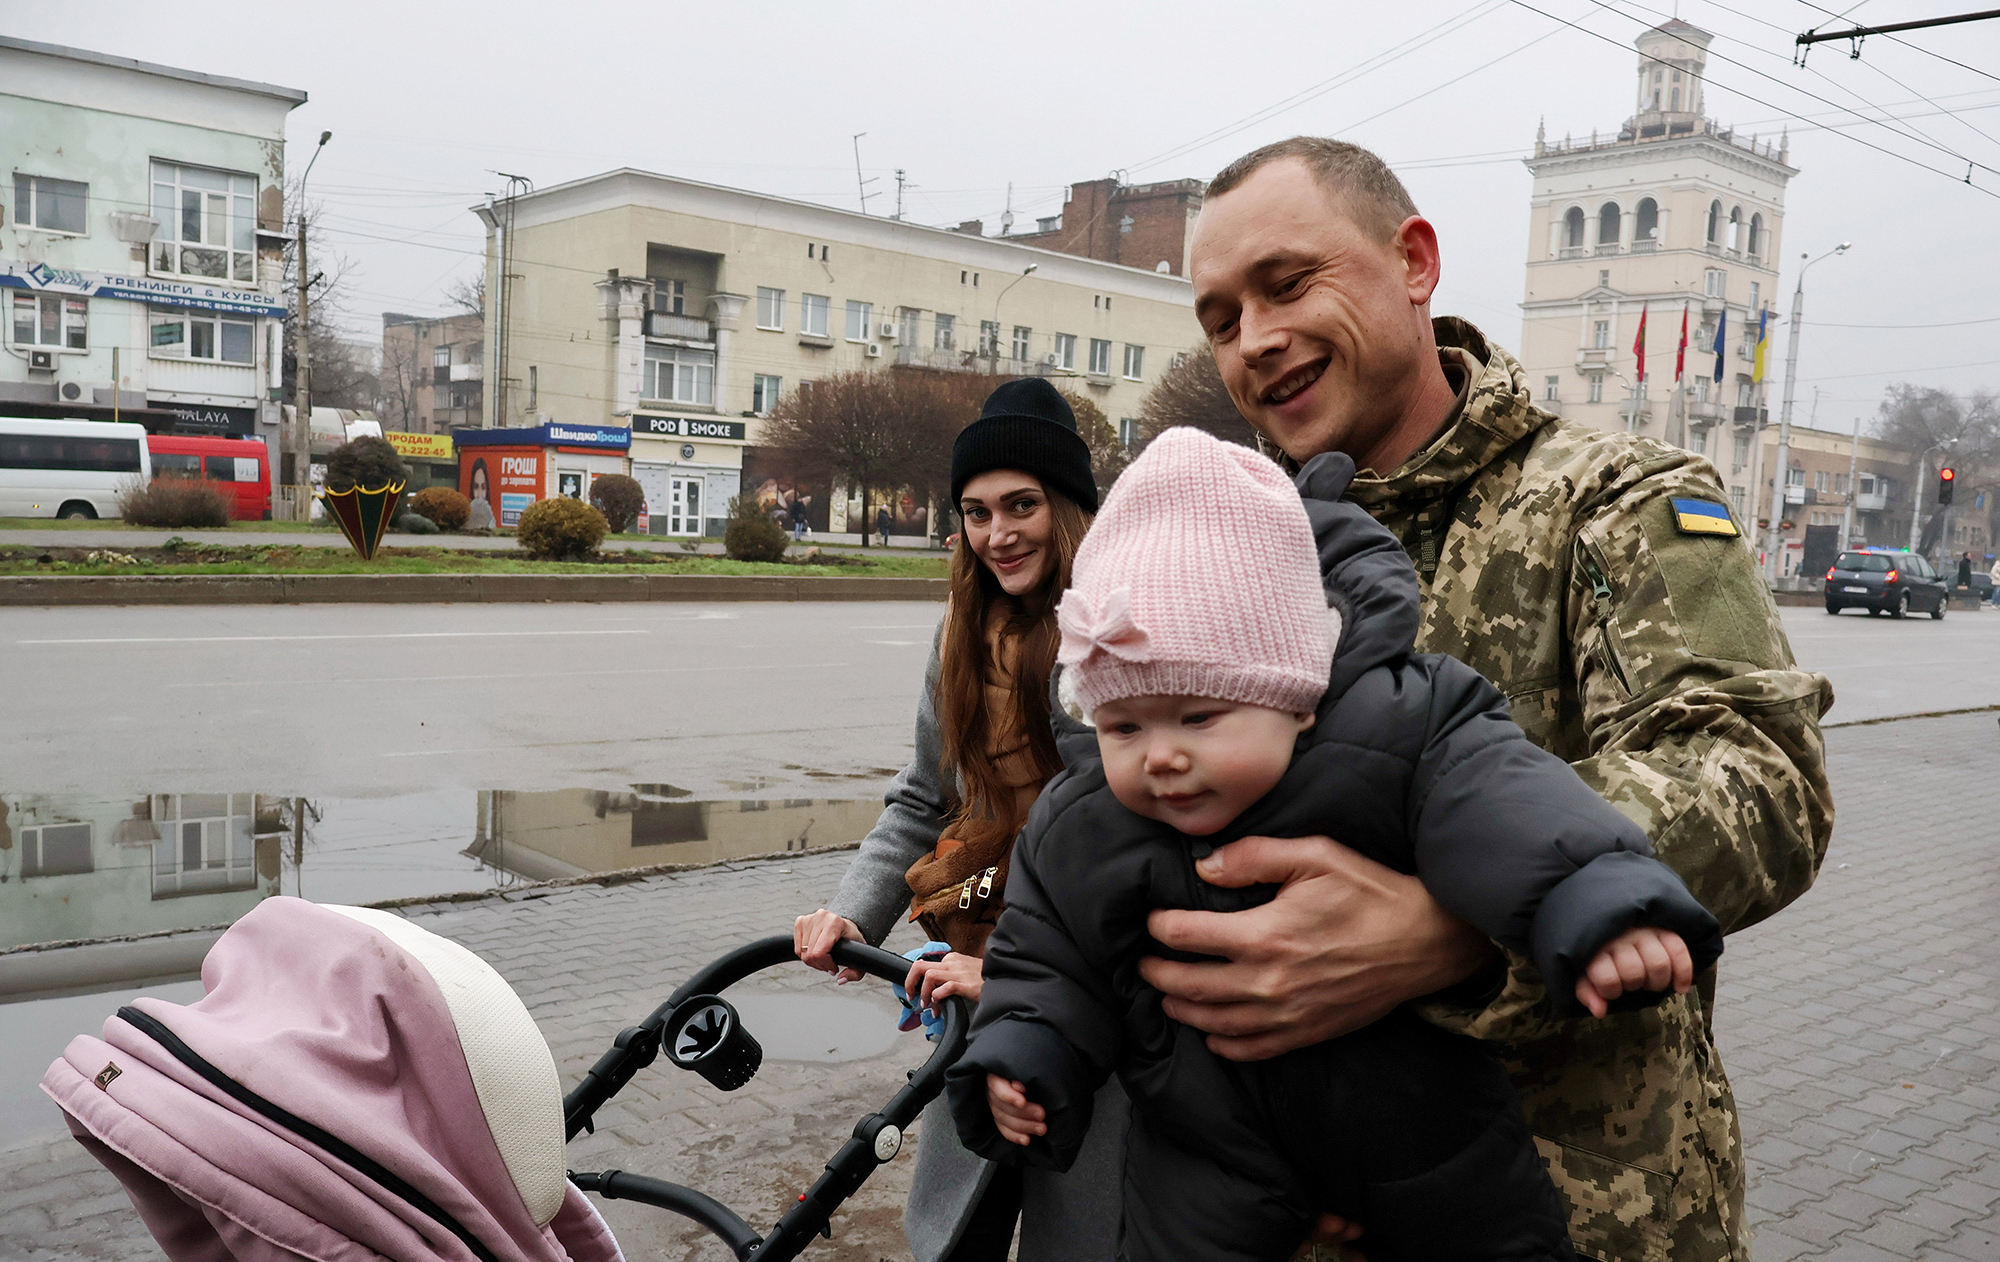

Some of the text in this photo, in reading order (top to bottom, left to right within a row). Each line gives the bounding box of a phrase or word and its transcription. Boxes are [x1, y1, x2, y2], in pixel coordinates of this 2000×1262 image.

[104, 276, 275, 304] ТРЕНИНГИ & КУРСЫ
[550, 427, 628, 443] ШвидкоГроші
[650, 419, 731, 437] POD SMOKE
[386, 434, 433, 445] ПРОДАМ
[501, 457, 537, 475] ГРОШІ
